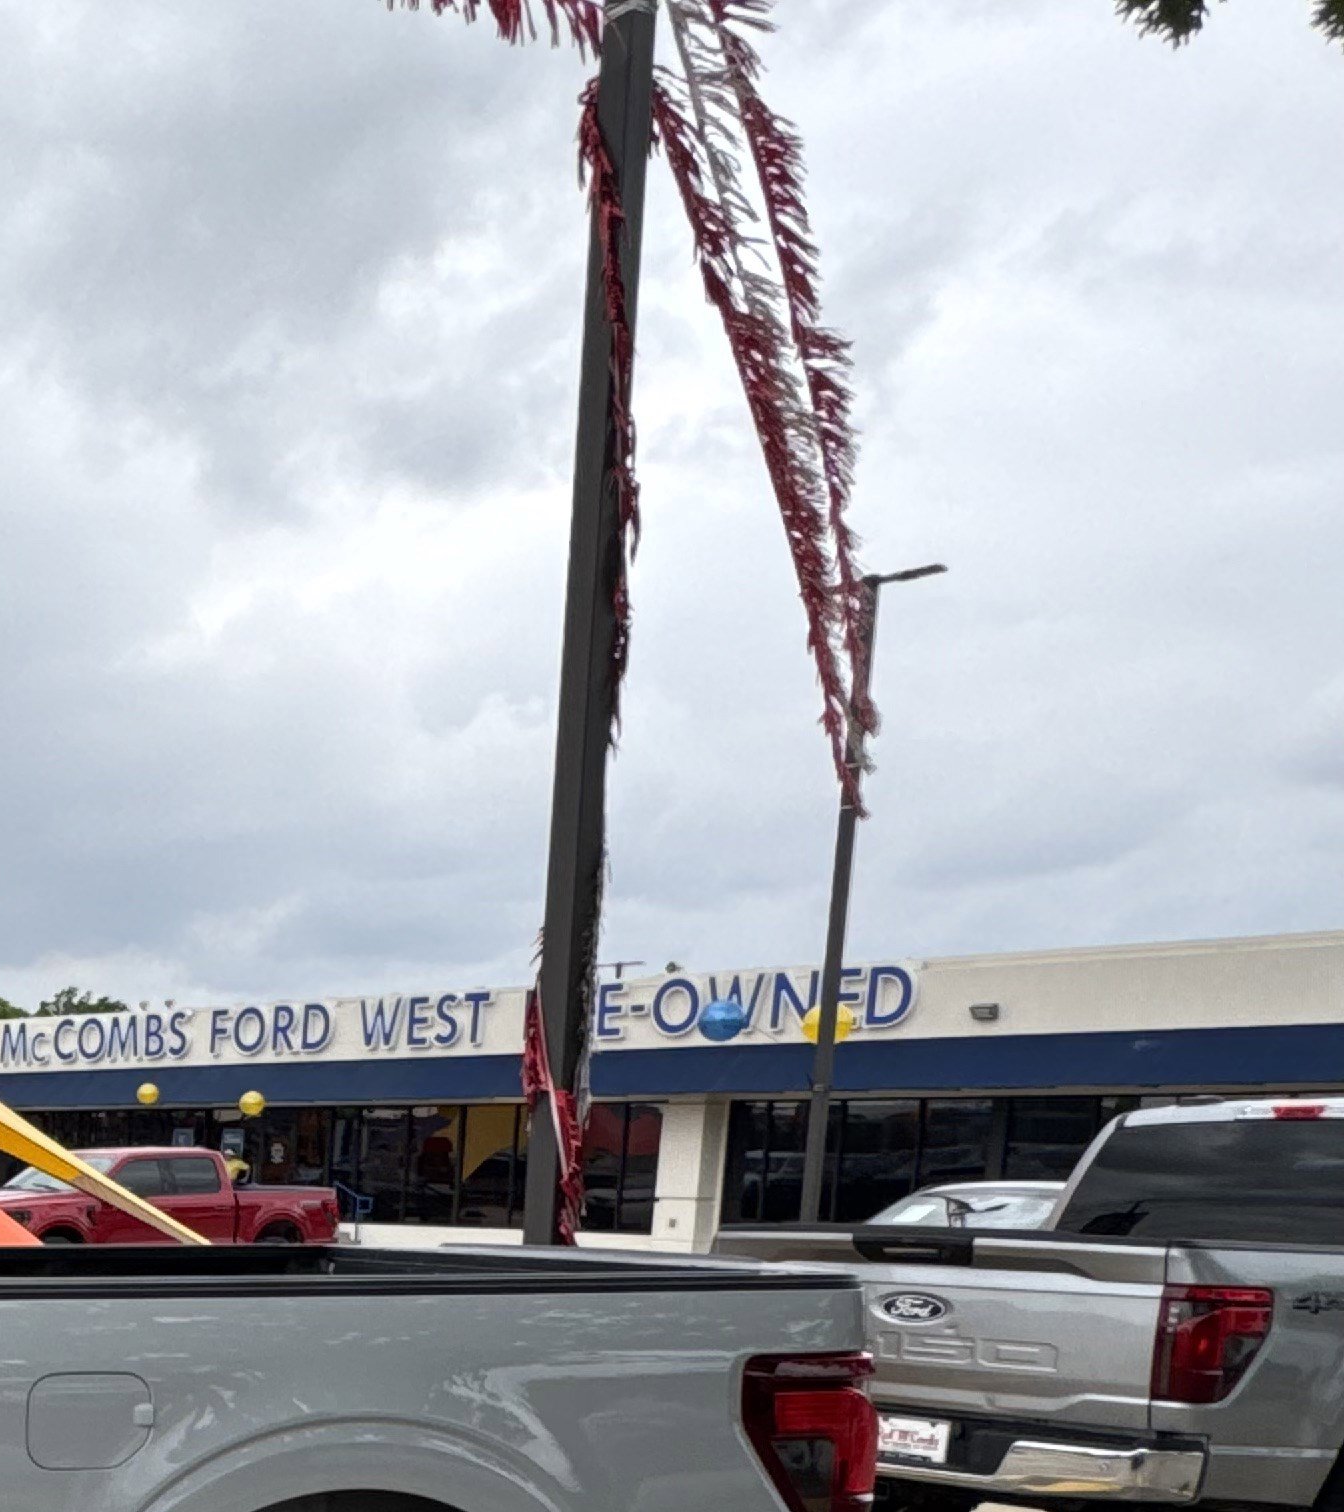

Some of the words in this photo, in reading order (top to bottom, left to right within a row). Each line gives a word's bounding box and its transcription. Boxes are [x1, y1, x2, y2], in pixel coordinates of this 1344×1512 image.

[0, 1011, 187, 1063] McCOMBS
[209, 1002, 331, 1053] FORD
[360, 991, 491, 1046] WEST
